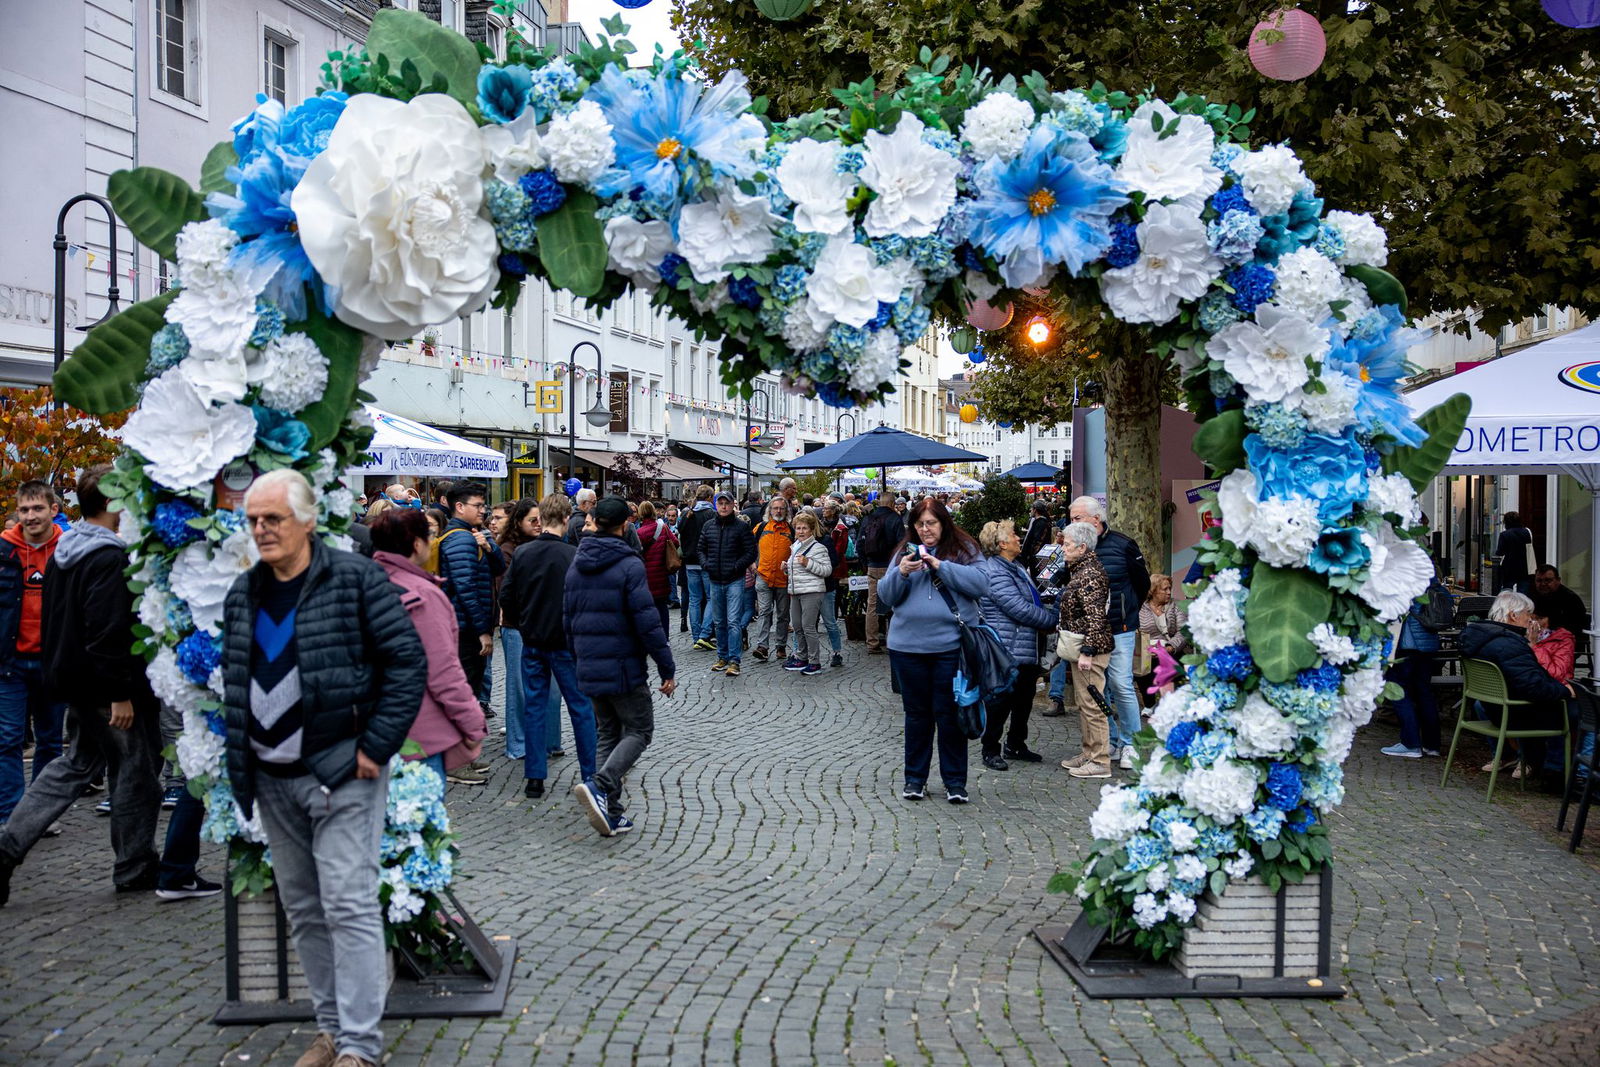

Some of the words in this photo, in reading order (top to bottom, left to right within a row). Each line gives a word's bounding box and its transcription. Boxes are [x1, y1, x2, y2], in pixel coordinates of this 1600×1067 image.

[610, 381, 622, 406] Villa
[610, 409, 622, 422] La
[400, 452, 459, 469] EUROMETROPOLE
